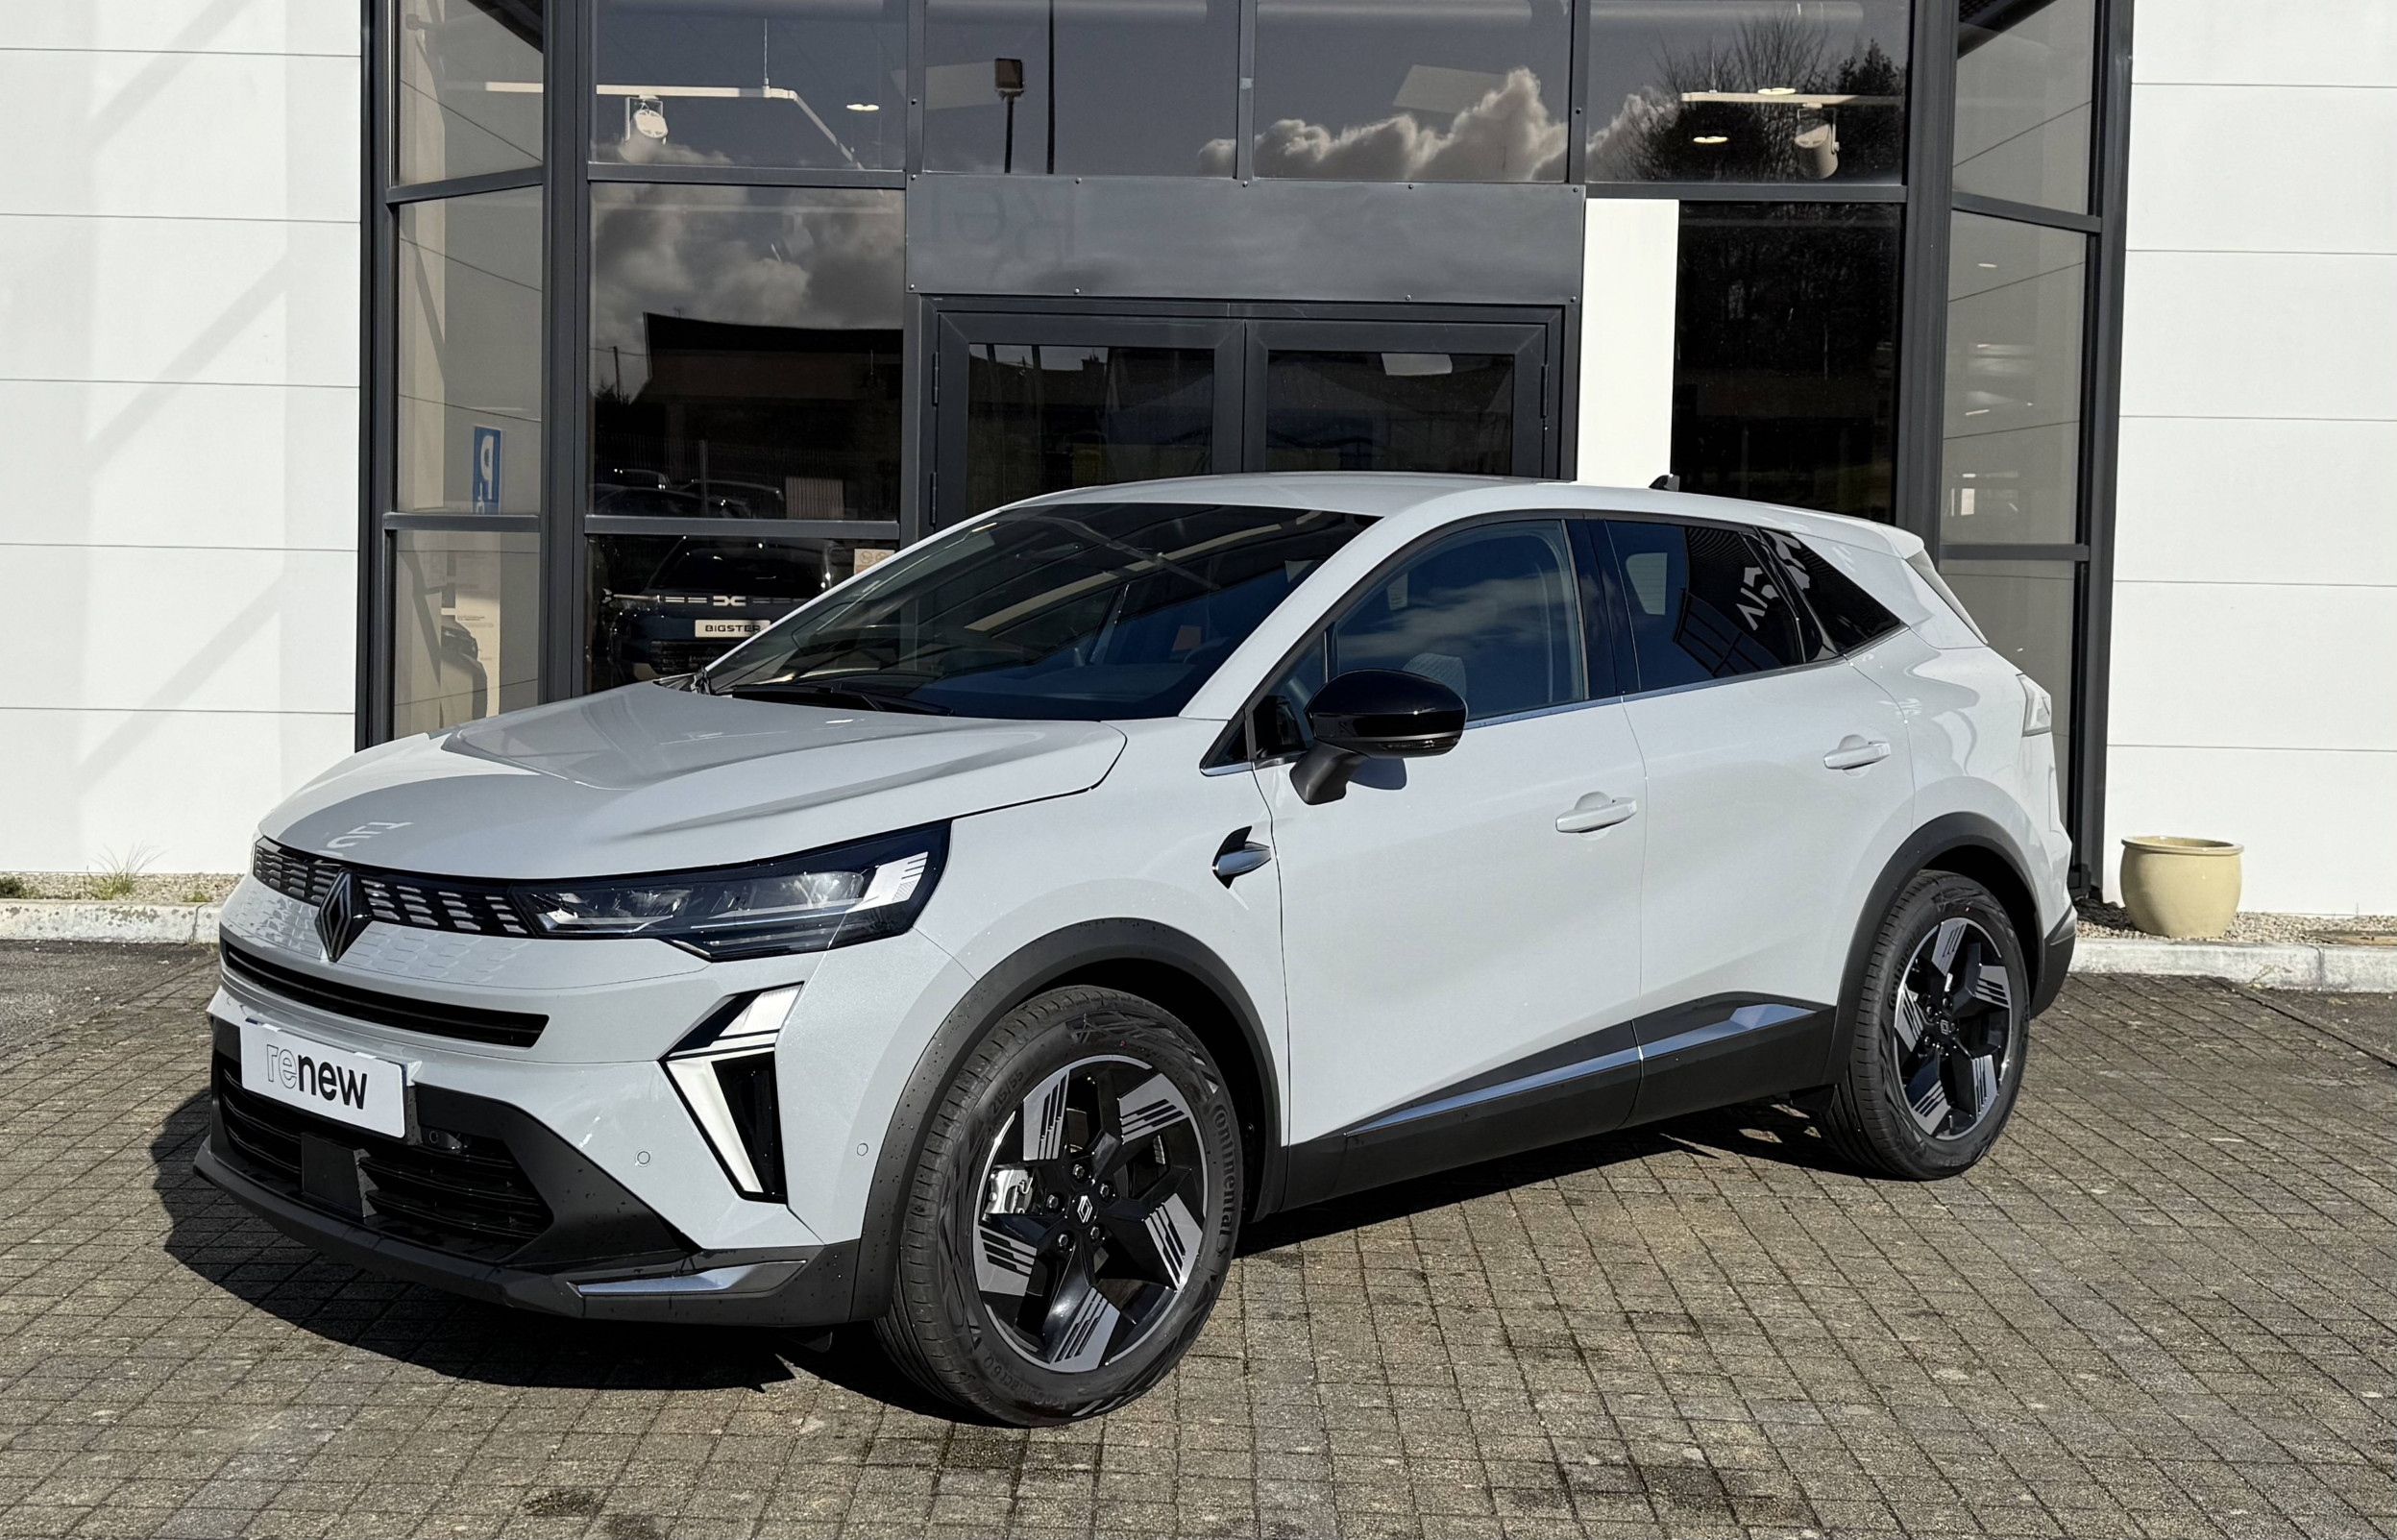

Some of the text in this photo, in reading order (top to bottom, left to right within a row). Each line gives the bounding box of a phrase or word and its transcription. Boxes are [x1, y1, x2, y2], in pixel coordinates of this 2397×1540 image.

[705, 624, 762, 633] BIGSTER
[266, 1043, 368, 1111] renew
[1211, 1104, 1236, 1236] Continental
